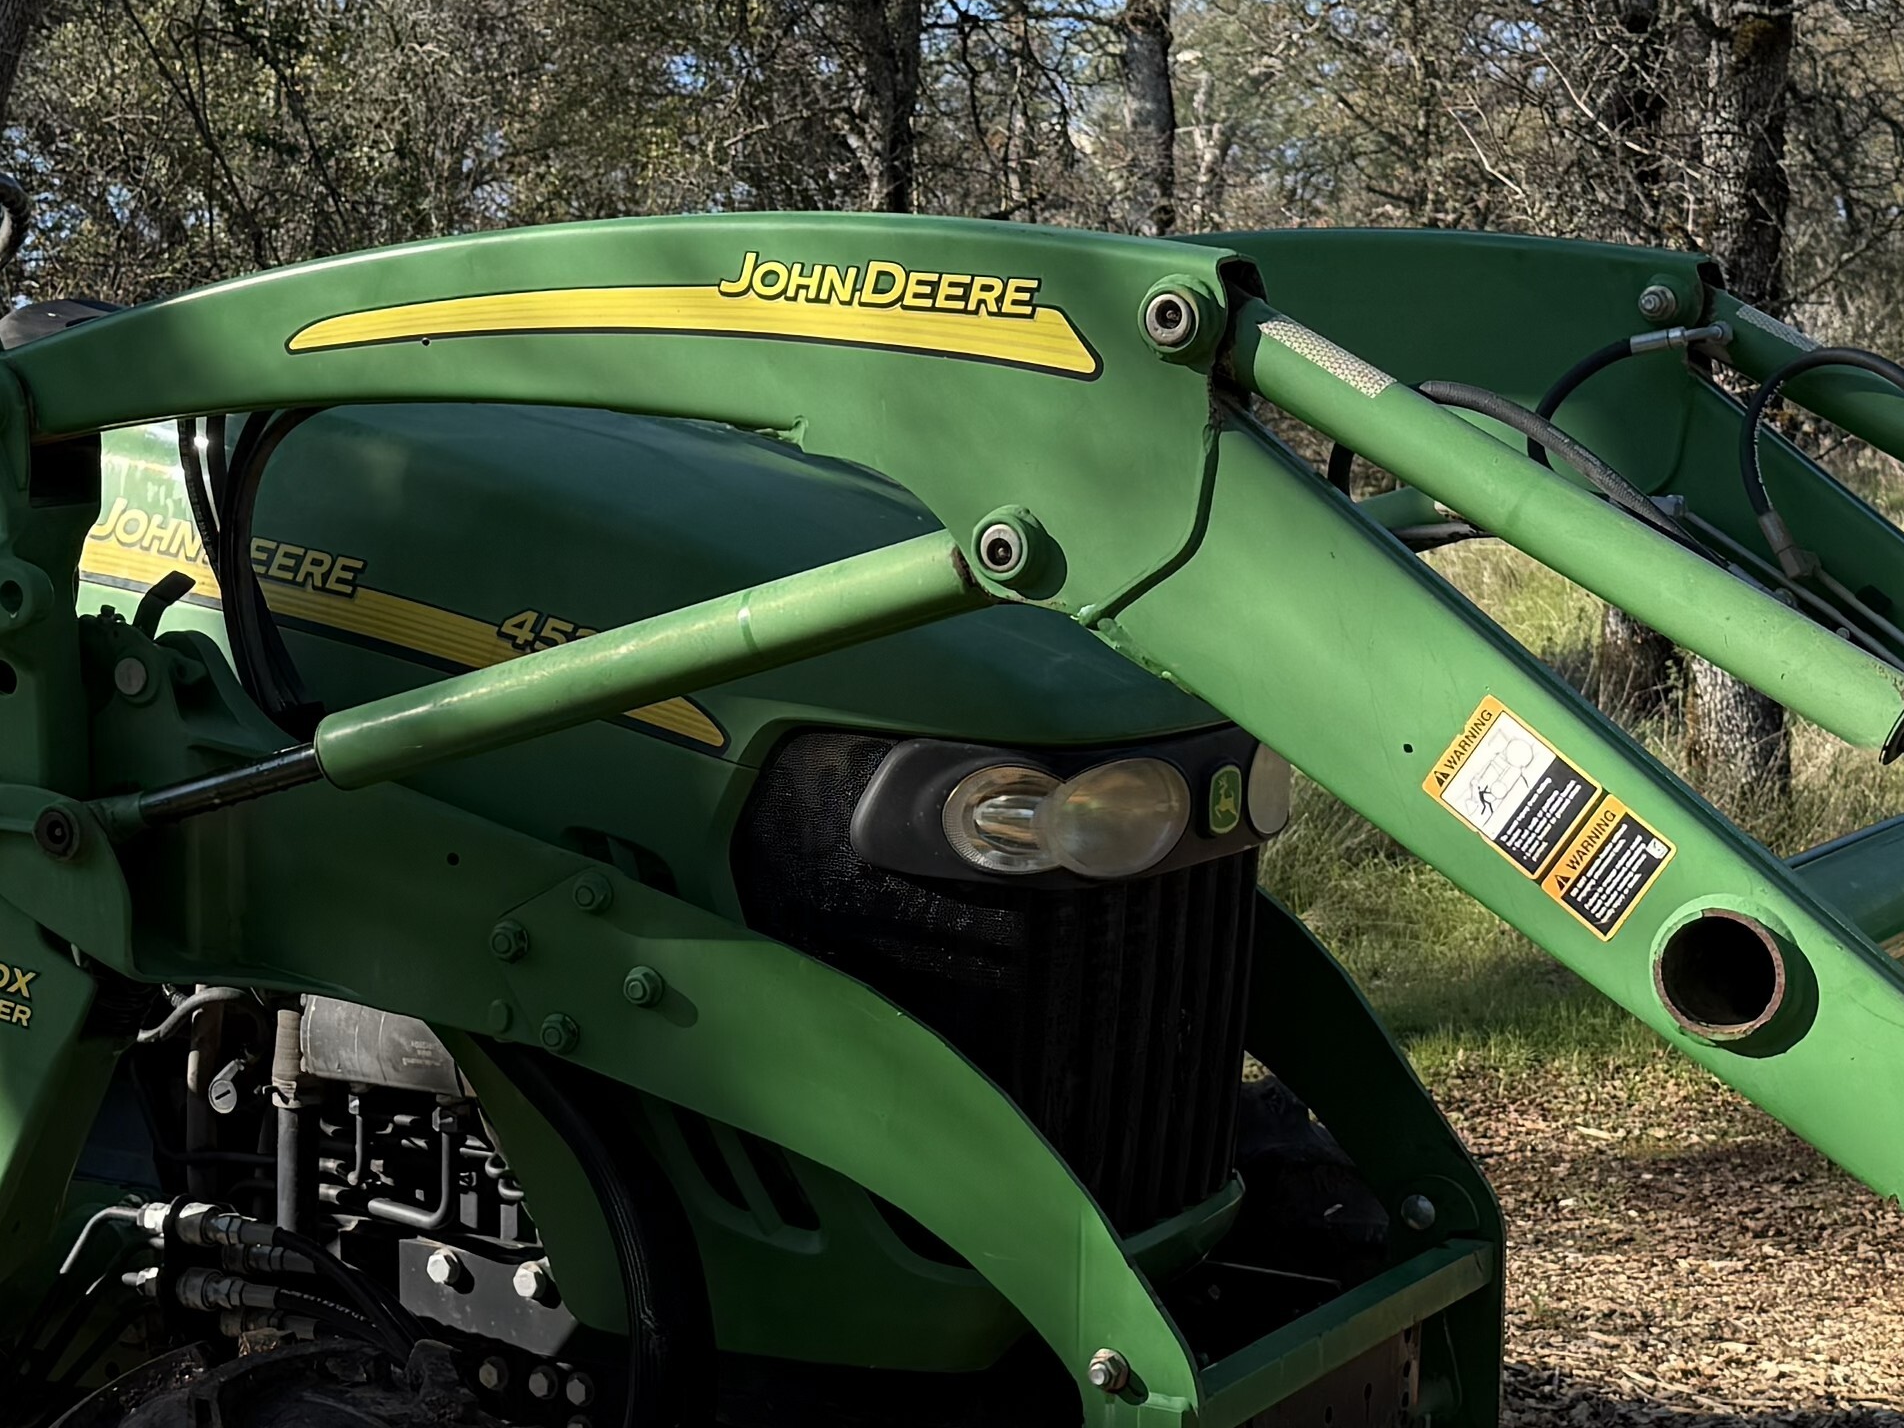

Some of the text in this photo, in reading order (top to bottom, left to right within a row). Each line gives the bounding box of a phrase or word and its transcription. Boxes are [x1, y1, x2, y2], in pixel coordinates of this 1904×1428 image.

[718, 251, 1041, 319] JOHN DEERE
[89, 496, 367, 598] JOHN EERE
[1444, 709, 1493, 771] WARNING
[1566, 809, 1616, 871] WARNING
